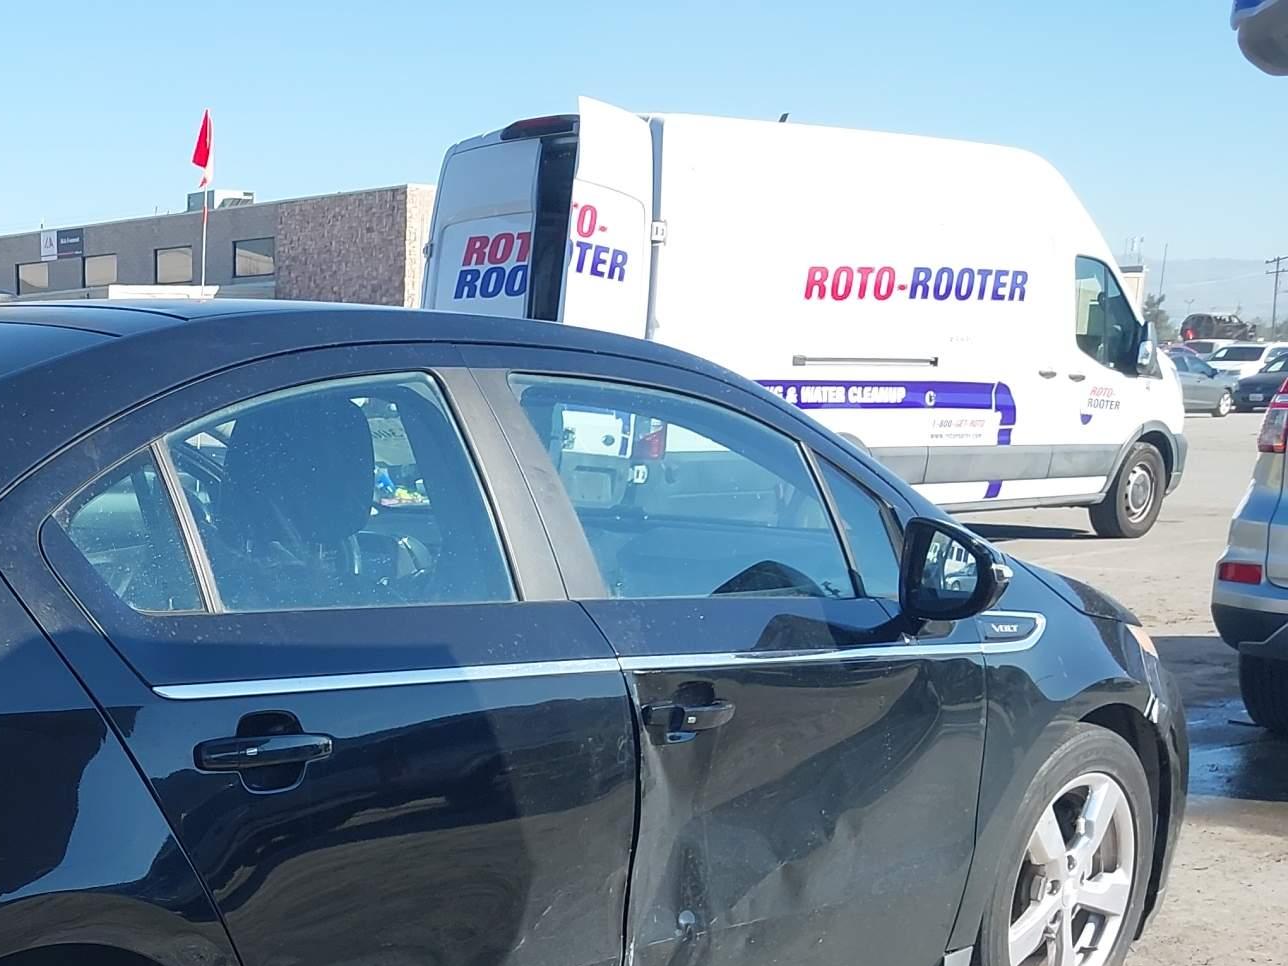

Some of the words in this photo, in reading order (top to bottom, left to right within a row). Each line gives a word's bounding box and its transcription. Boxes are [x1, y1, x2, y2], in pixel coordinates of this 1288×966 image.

[804, 266, 1029, 301] ROTO-ROOTER
[785, 387, 798, 403] &
[800, 387, 846, 403] WATER
[847, 387, 907, 404] CLEANUP
[1087, 398, 1121, 410] ROOTER
[992, 623, 1018, 633] VOLT
